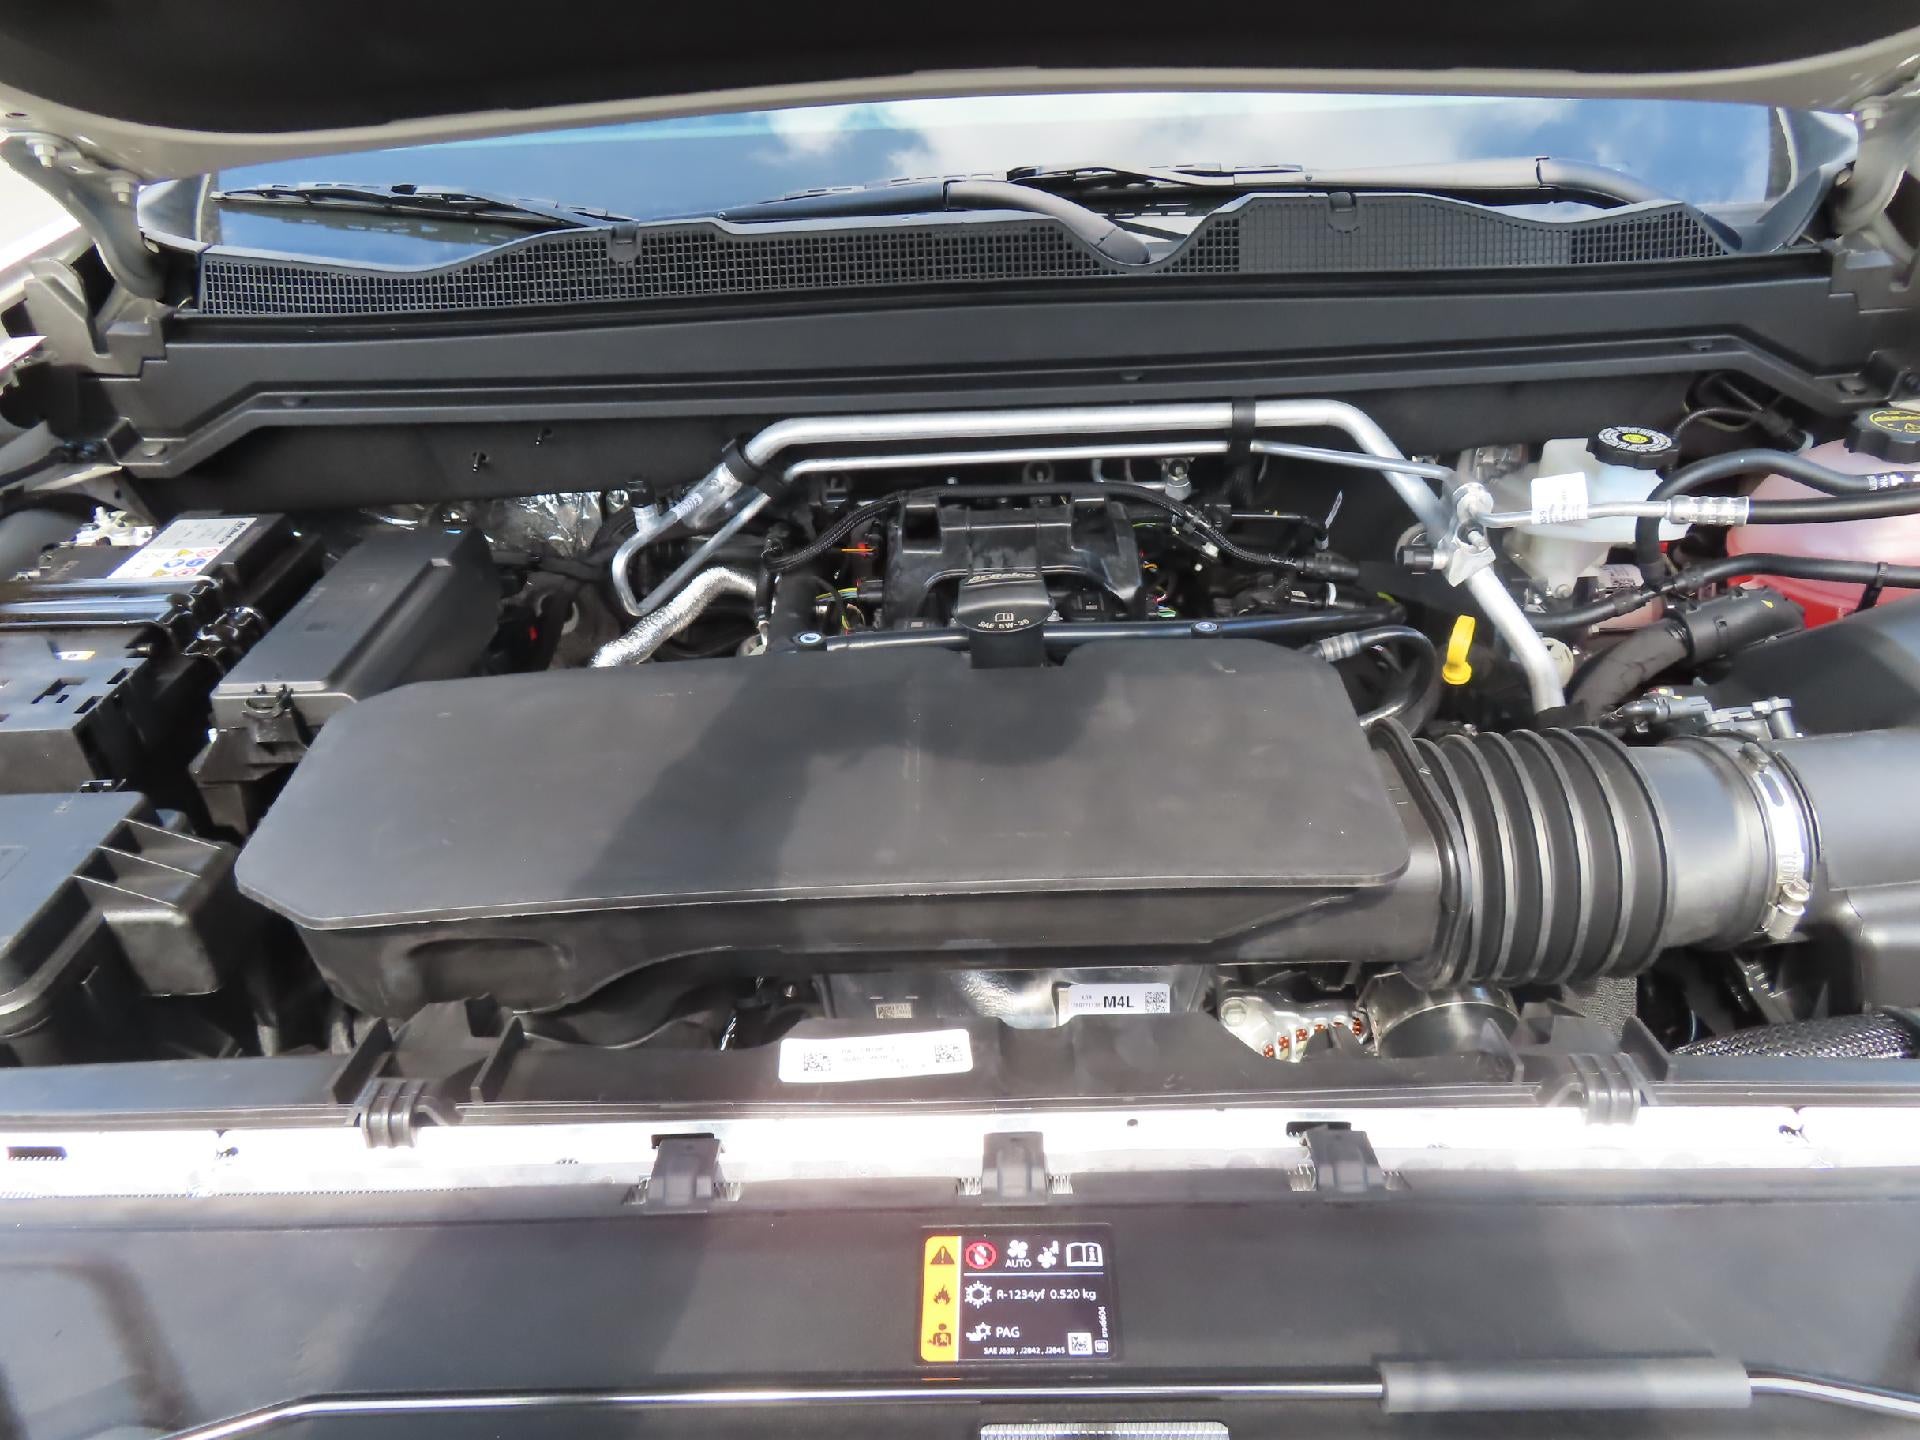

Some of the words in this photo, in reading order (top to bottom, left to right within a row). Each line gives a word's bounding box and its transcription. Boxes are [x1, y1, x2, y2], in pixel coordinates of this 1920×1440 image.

[1103, 995, 1135, 1008] M4L
[1005, 1258, 1031, 1268] AUTO
[996, 1288, 1045, 1301] R-1234yf
[1049, 1288, 1080, 1300] 0.520
[1082, 1288, 1097, 1301] kg
[995, 1326, 1020, 1338] PAG
[983, 1346, 998, 1355] SAE
